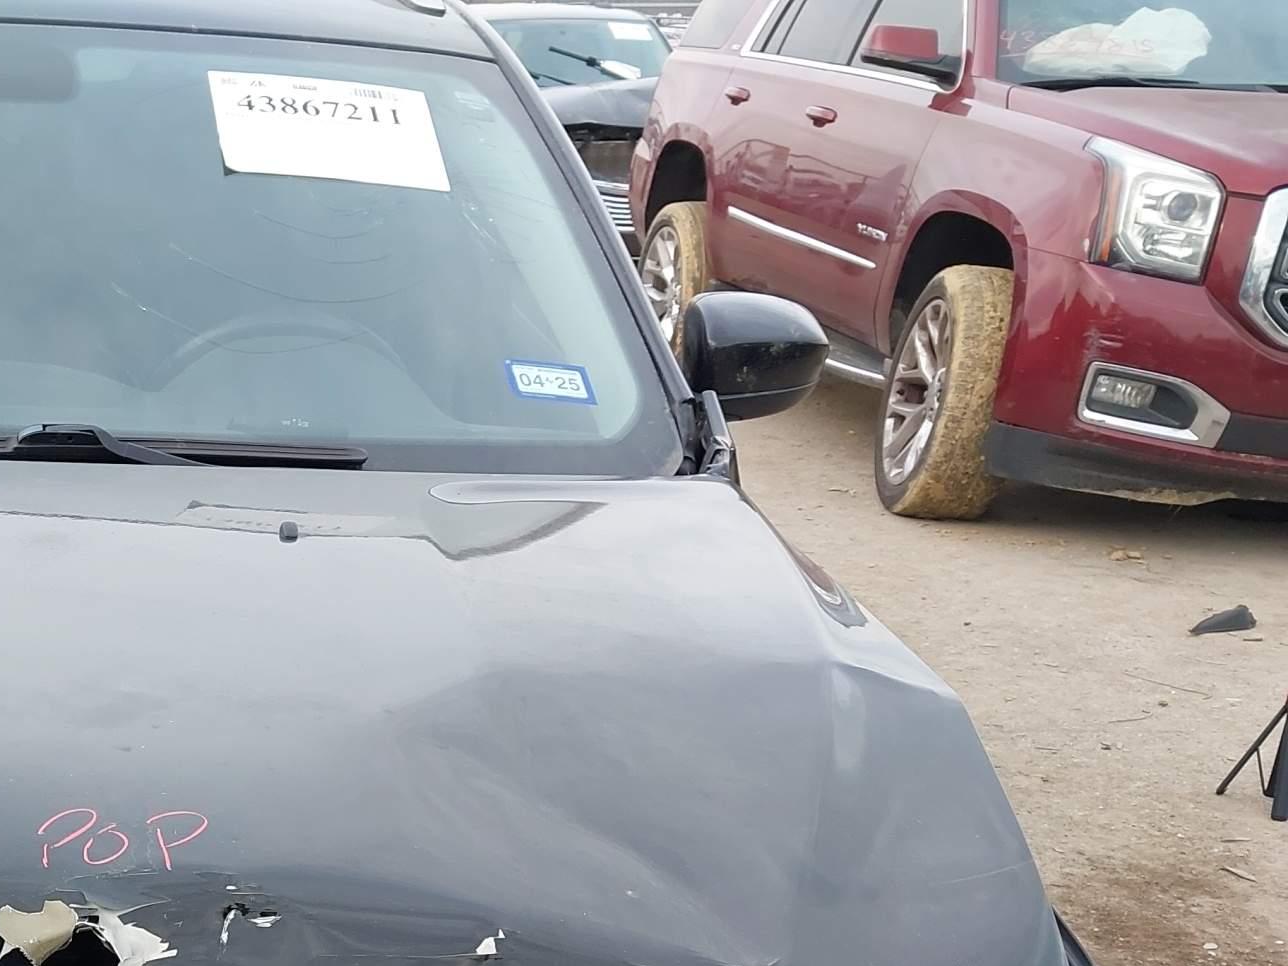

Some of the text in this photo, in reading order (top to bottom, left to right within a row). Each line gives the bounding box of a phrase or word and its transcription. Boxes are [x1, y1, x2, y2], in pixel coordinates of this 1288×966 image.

[236, 94, 402, 125] 43867211
[519, 372, 546, 388] 04
[554, 376, 581, 392] 25
